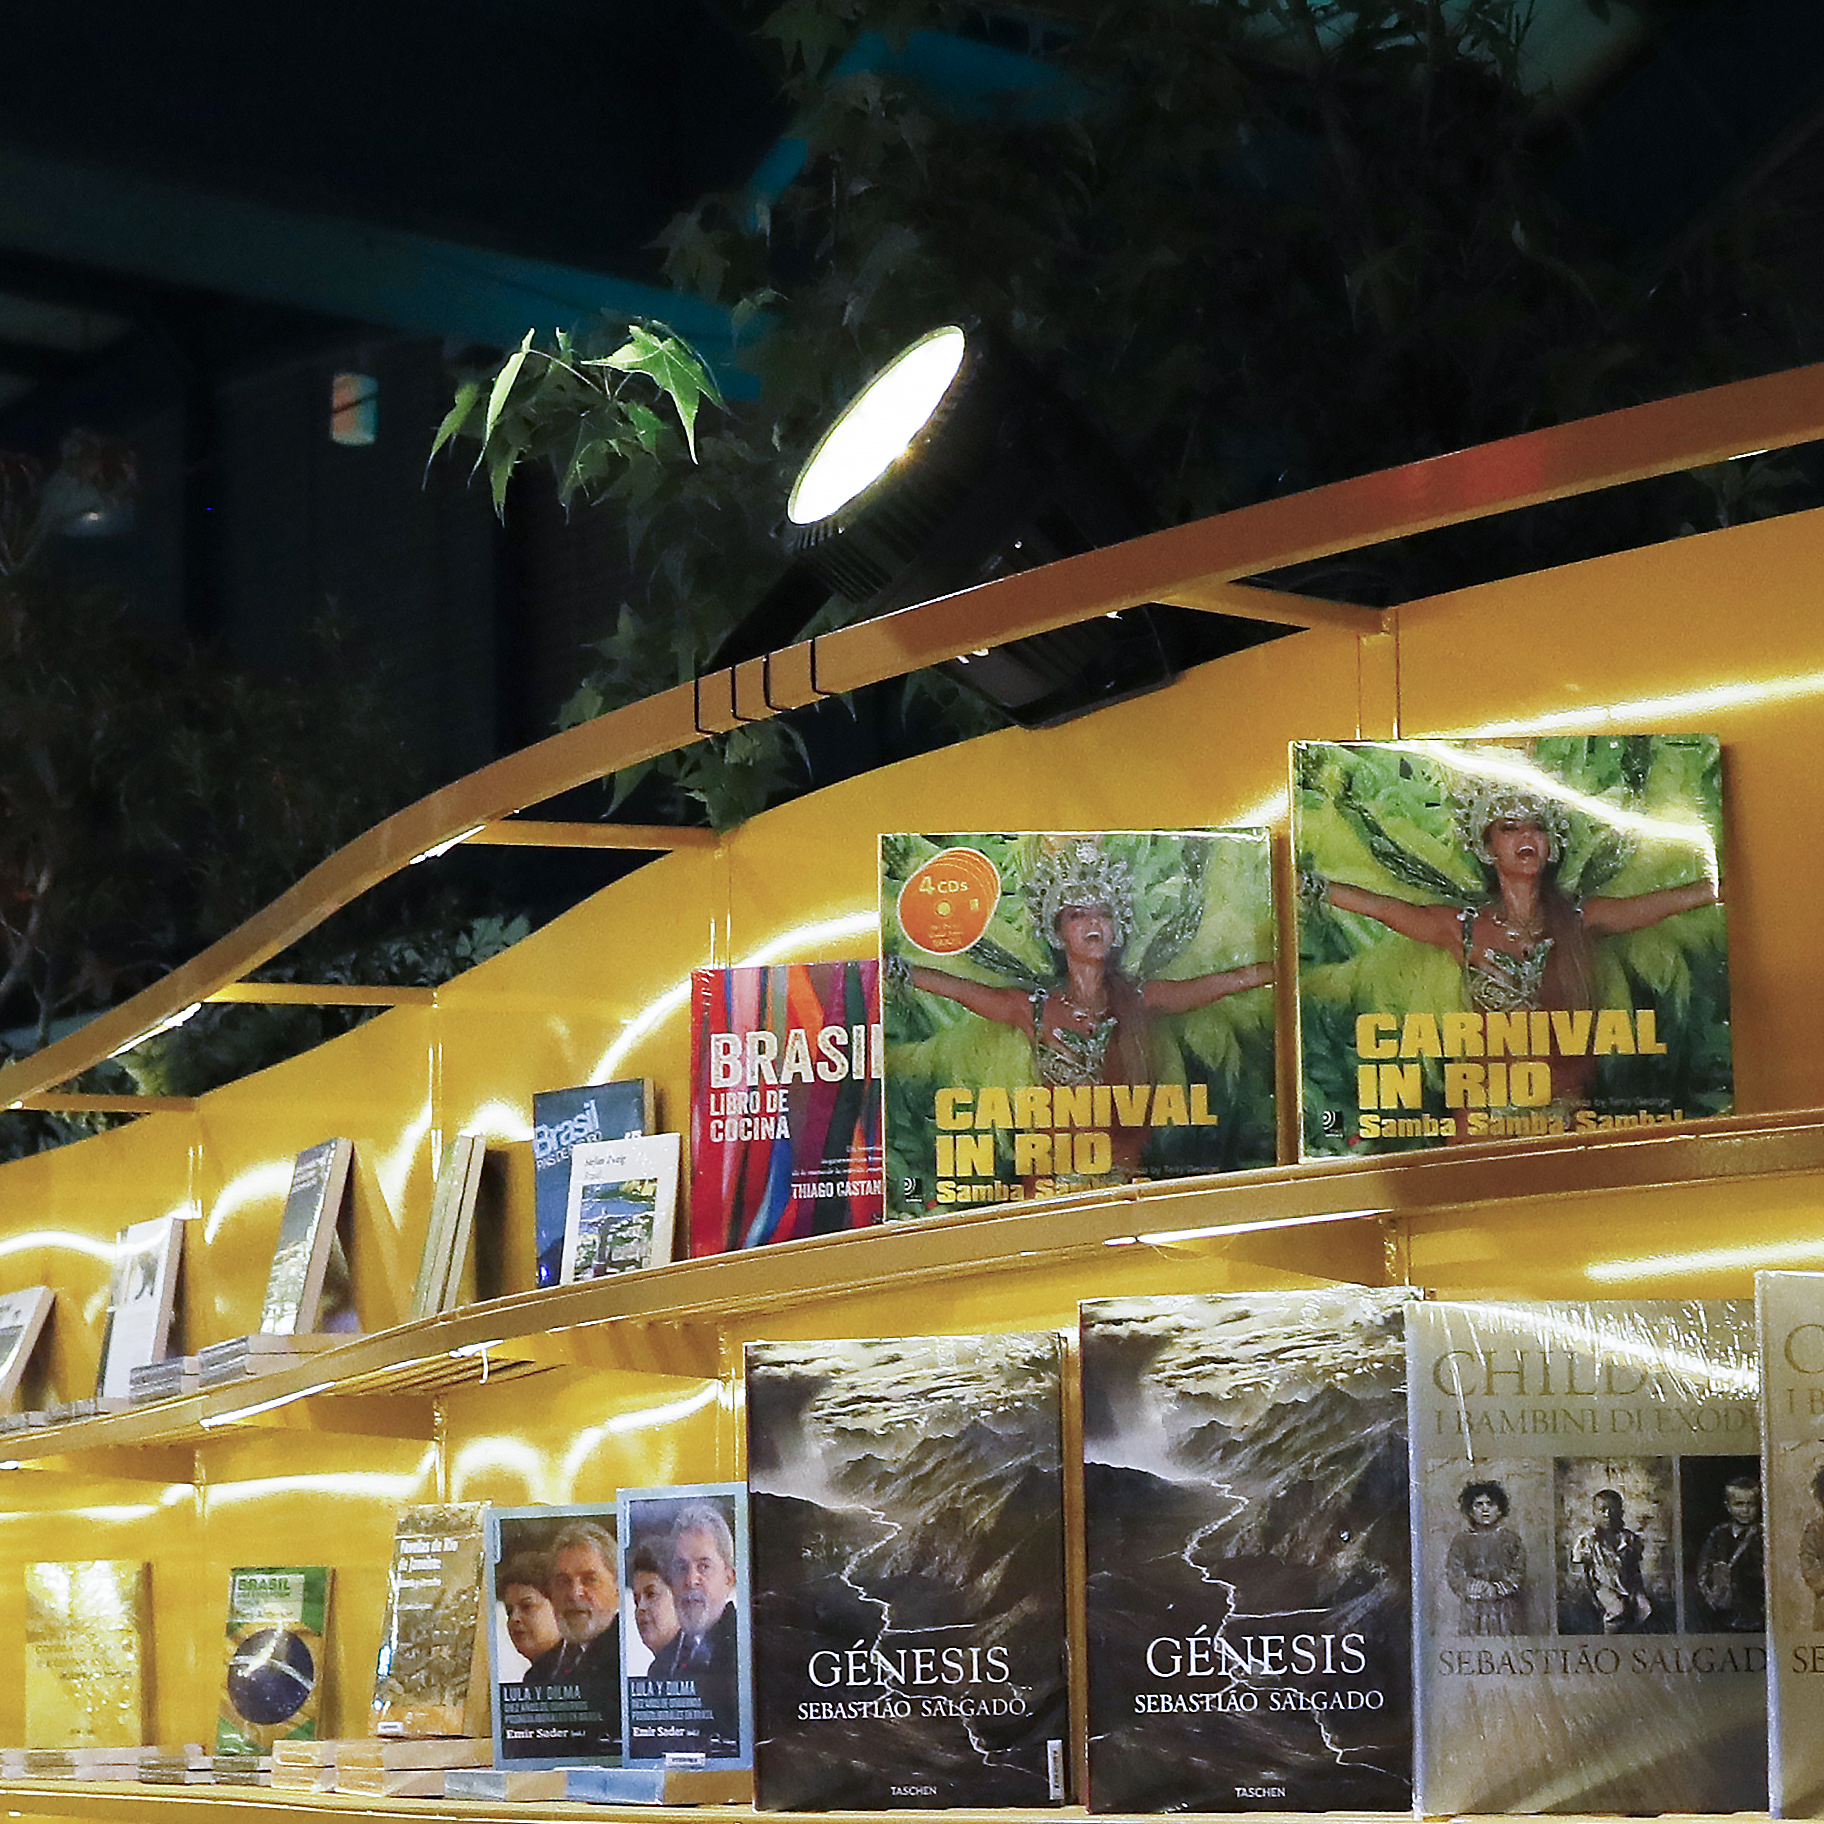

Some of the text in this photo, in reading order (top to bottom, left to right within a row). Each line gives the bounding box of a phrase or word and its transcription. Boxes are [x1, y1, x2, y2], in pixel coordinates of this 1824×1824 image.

[919, 876, 968, 895] 4 CDs
[1355, 1009, 1667, 1060] CARNIVAL
[1357, 1062, 1551, 1110] IN RIO
[710, 1089, 789, 1116] LIBRO DE
[935, 1084, 1218, 1130] CARNIVAL
[532, 1099, 600, 1160] Brasil
[710, 1116, 791, 1142] COCINA
[1359, 1113, 1456, 1138] Samba
[1467, 1112, 1565, 1136] Samba
[936, 1134, 994, 1177] IN
[1015, 1131, 1112, 1176] RIO
[791, 1182, 833, 1199] THIAGO
[936, 1180, 1024, 1203] Samba
[1457, 1407, 1597, 1435] BAMBINI
[1610, 1407, 1643, 1433] DI
[808, 1640, 1010, 1688] GÉNESIS
[1146, 1625, 1366, 1679] GÉNESIS
[1439, 1645, 1620, 1676] SEBASTIÃO
[504, 1687, 531, 1701] LULA
[1134, 1689, 1384, 1714] SEBASTIÃO SALGADO
[797, 1697, 1026, 1721] SEBASTIÃO SALGADO
[891, 1785, 938, 1797] TASCHEN
[1235, 1786, 1286, 1798] TASCHEN
